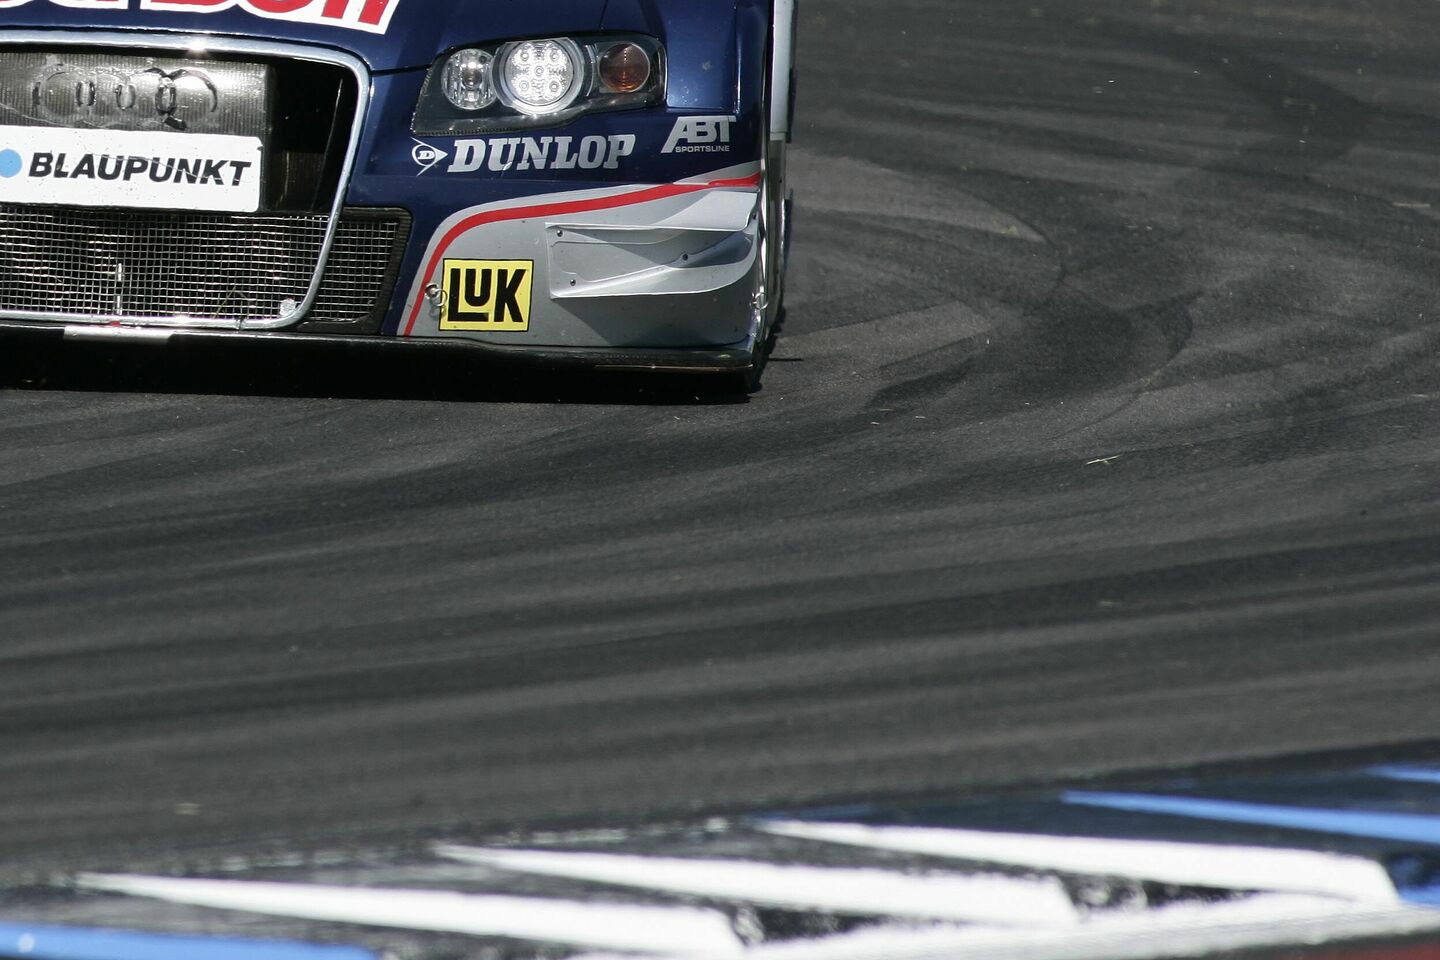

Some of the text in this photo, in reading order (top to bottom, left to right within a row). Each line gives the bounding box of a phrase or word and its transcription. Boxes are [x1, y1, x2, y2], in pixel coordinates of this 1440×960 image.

[660, 115, 737, 154] ABT
[675, 145, 731, 154] SPORTSLINE
[28, 151, 252, 187] BLAUPUNKT
[447, 134, 636, 173] DUNLOP
